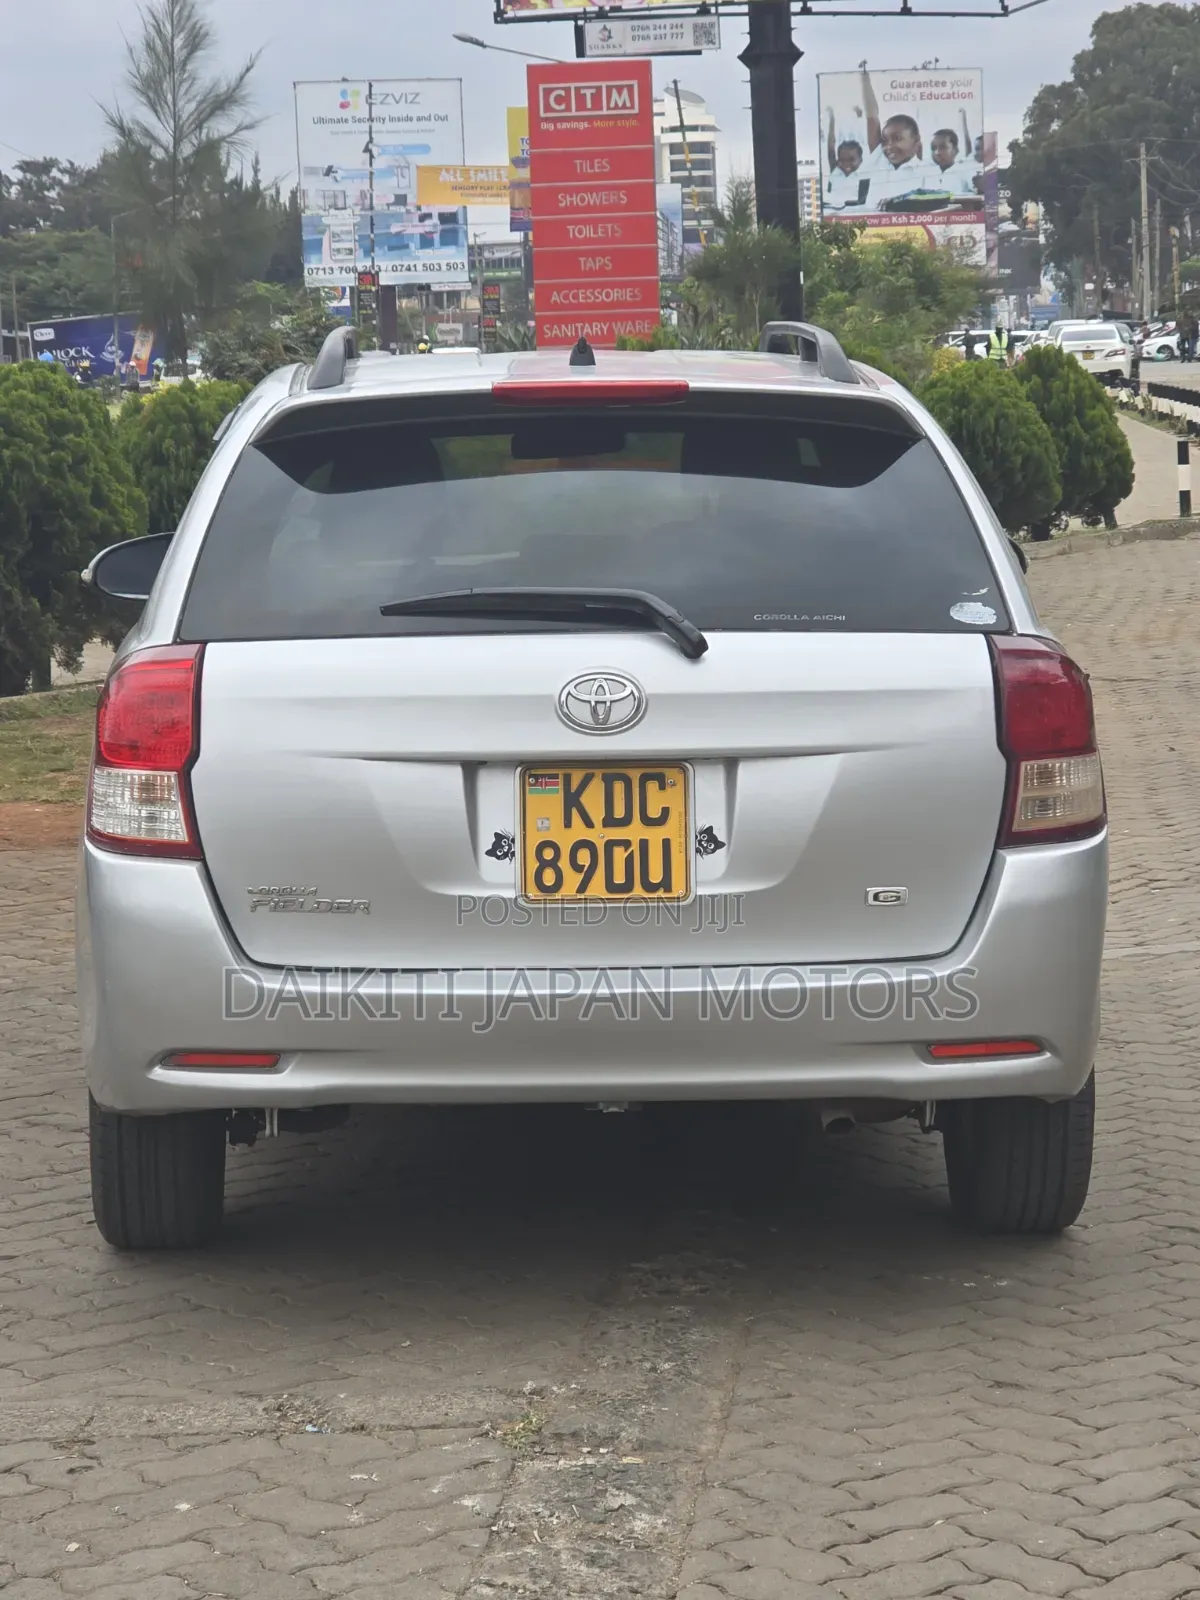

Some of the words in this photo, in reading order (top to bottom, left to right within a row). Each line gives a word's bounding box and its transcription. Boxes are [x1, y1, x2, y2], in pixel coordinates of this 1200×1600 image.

[652, 23, 667, 31] 244
[669, 22, 684, 30] 244
[670, 31, 684, 39] 777
[890, 78, 948, 90] Guarantee
[949, 78, 973, 90] your
[548, 86, 632, 110] CTM
[882, 91, 917, 102] Child's
[919, 90, 974, 101] Education
[312, 115, 350, 125] Ultimate
[388, 113, 414, 124] Inside
[415, 113, 432, 122] and
[433, 113, 449, 122] Out
[540, 121, 554, 131] Big
[556, 120, 592, 130] savings.
[593, 119, 615, 128] More
[616, 117, 640, 129] style.
[573, 158, 611, 173] TILES
[438, 168, 465, 183] ALL
[479, 184, 494, 192] PLAY
[558, 190, 628, 207] SHOWERS
[891, 215, 908, 224] Ksh
[909, 214, 933, 224] 2,000
[934, 215, 948, 225] per
[566, 223, 623, 239] TOILETS
[307, 266, 334, 276] 0713
[337, 265, 358, 275] 700
[391, 262, 418, 272] 0741
[422, 261, 442, 272] 503
[446, 260, 466, 271] 503
[578, 256, 613, 271] TAPS
[550, 287, 643, 304] ACCESSORIES
[543, 321, 611, 338] SANITARY
[611, 319, 652, 335] WARE
[753, 613, 810, 621] COROLLA
[812, 613, 846, 621] AICHI
[561, 771, 671, 829] KDC
[872, 889, 902, 903] G
[250, 897, 371, 914] FIELDER
